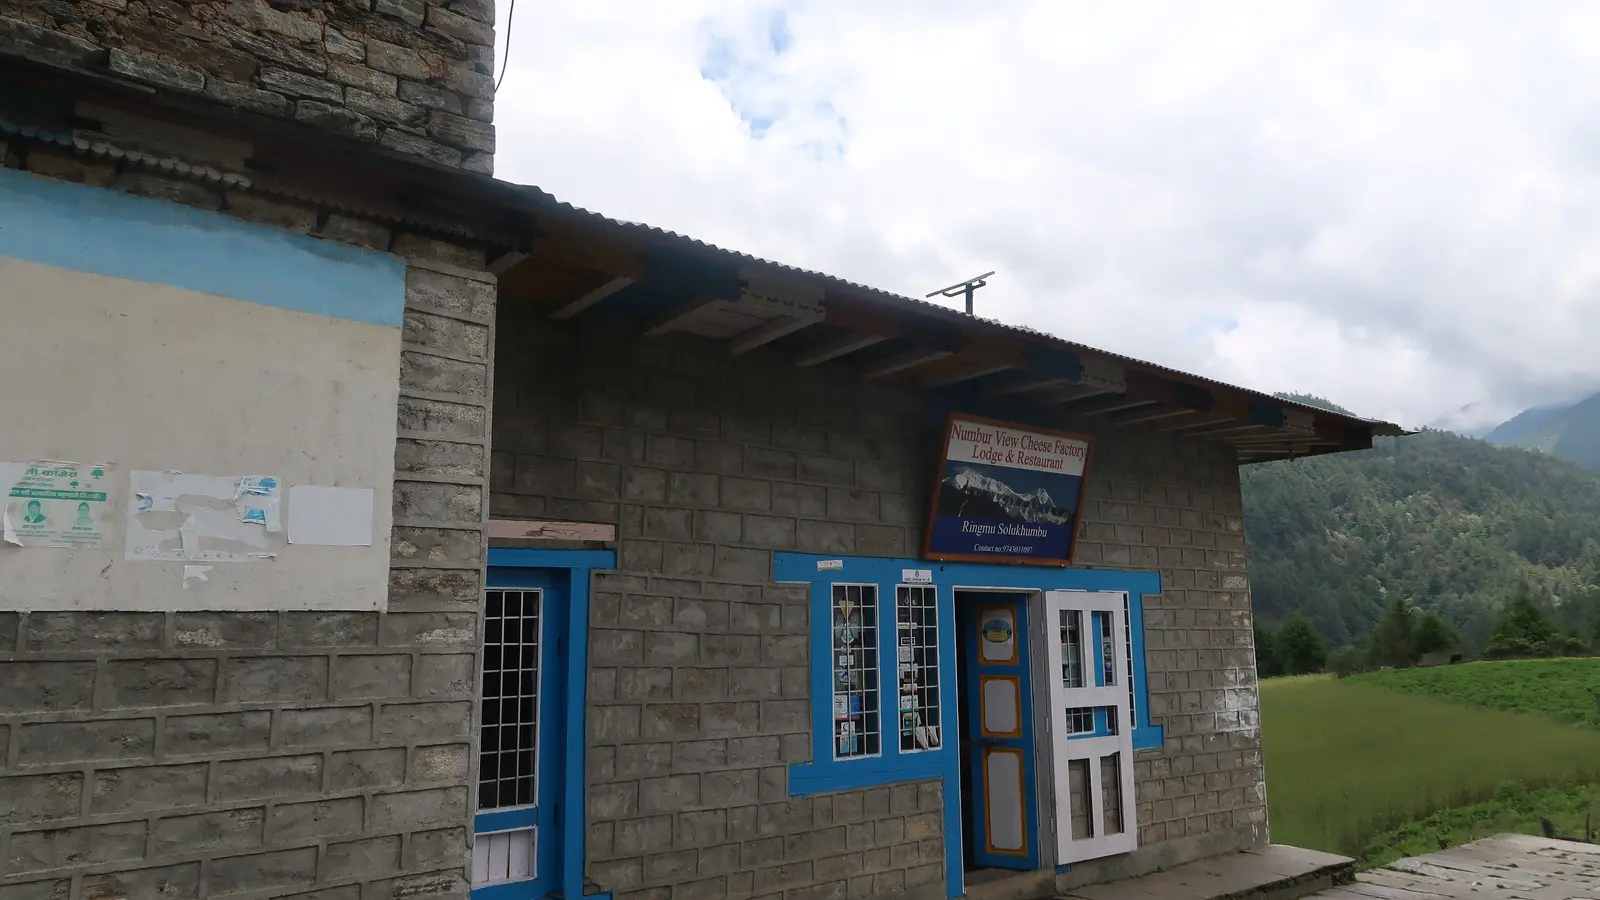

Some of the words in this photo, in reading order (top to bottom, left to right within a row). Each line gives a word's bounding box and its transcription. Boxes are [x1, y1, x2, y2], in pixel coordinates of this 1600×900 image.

[951, 424, 993, 444] Numbur
[996, 430, 1019, 447] View
[1021, 434, 1052, 453] Cheese
[1054, 440, 1087, 460] Factory
[972, 445, 1003, 464] Lodge
[1005, 452, 1014, 463] &
[1017, 450, 1064, 470] Restaurant
[962, 520, 996, 536] Ringmu
[998, 523, 1047, 537] Solukhumbu
[974, 544, 994, 552] Contact
